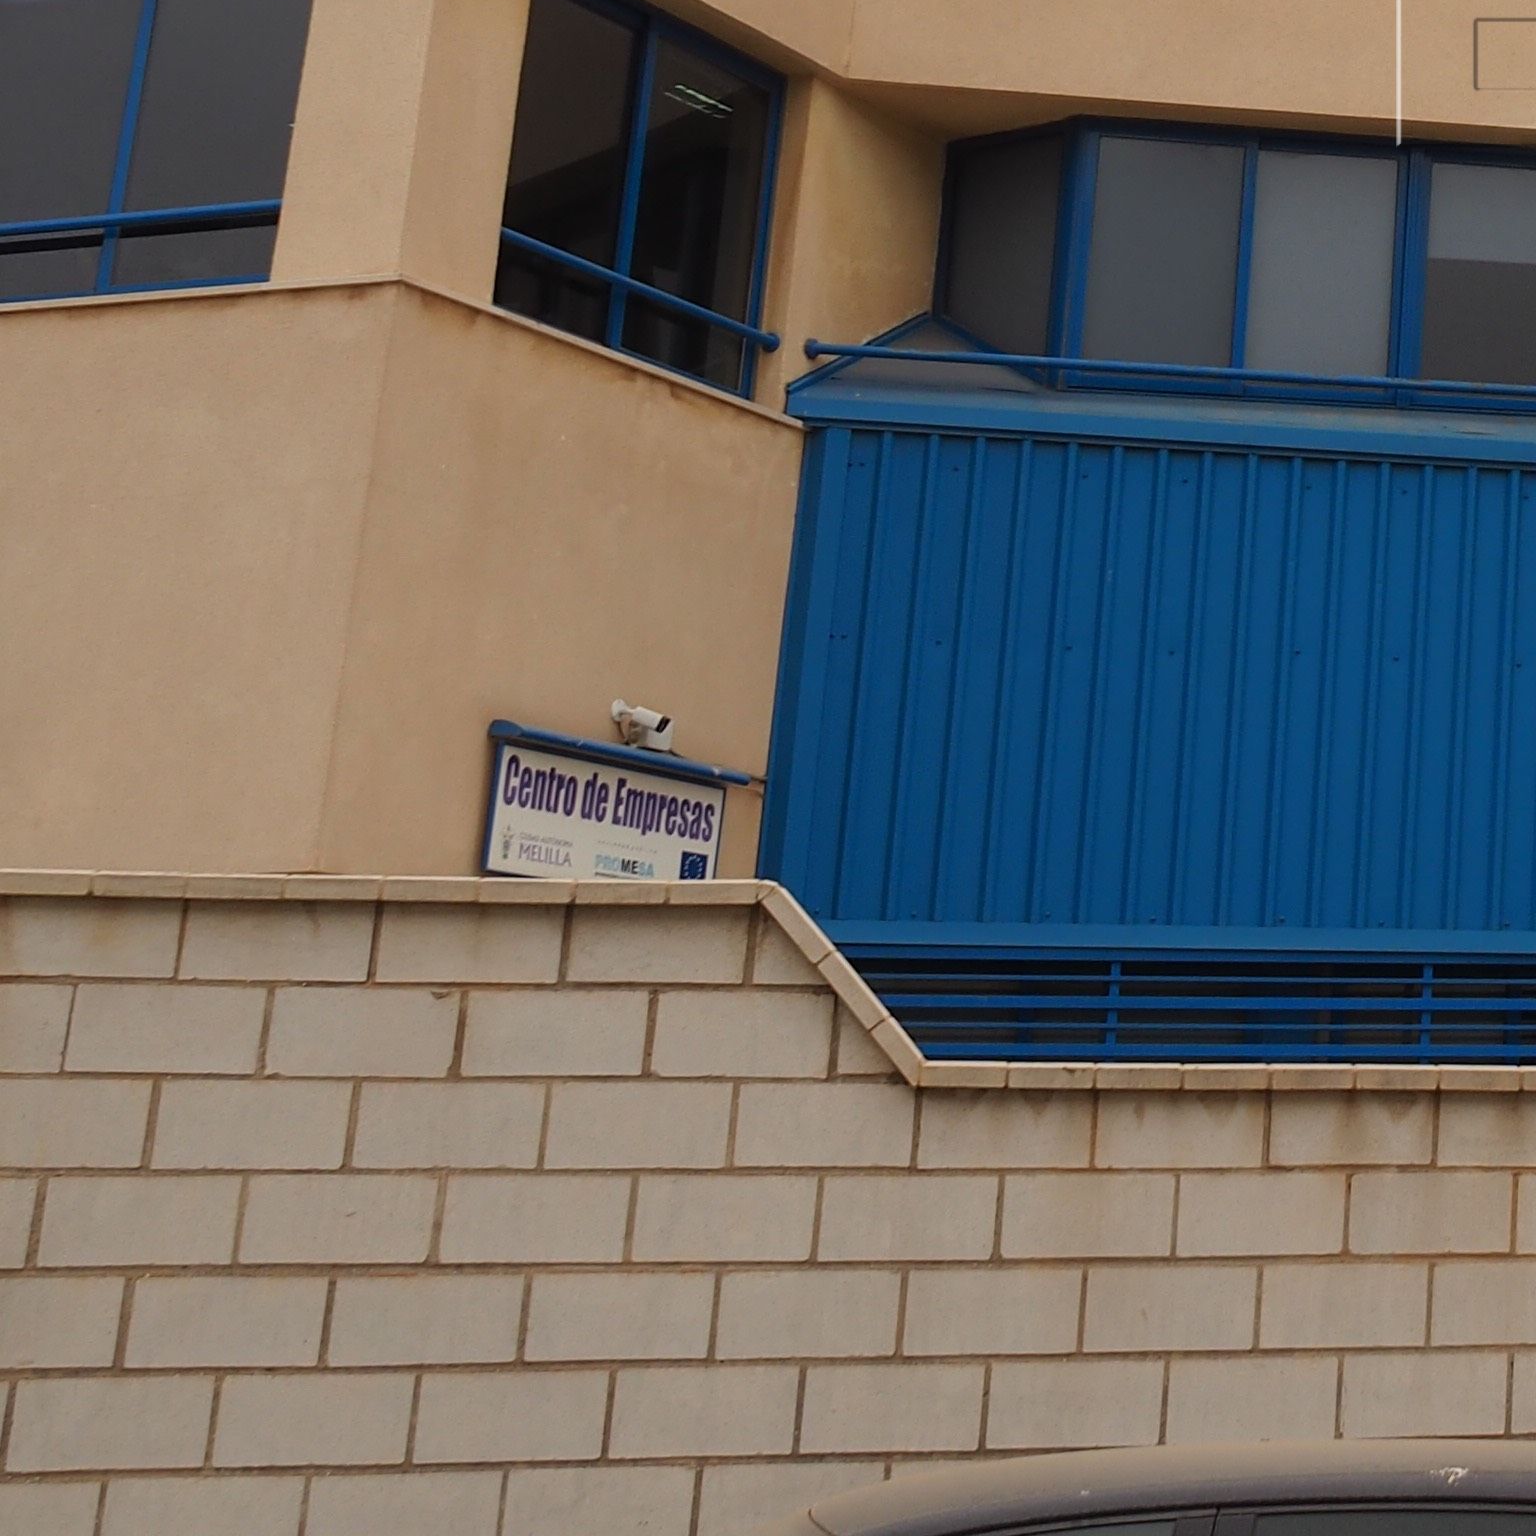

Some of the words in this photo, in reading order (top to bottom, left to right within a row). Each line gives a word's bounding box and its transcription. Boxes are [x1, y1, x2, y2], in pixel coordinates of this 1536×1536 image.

[503, 754, 578, 816] Centro
[580, 773, 609, 823] de
[612, 777, 716, 843] Empresas
[518, 843, 572, 867] MELILLA
[595, 854, 655, 877] PROMESA
